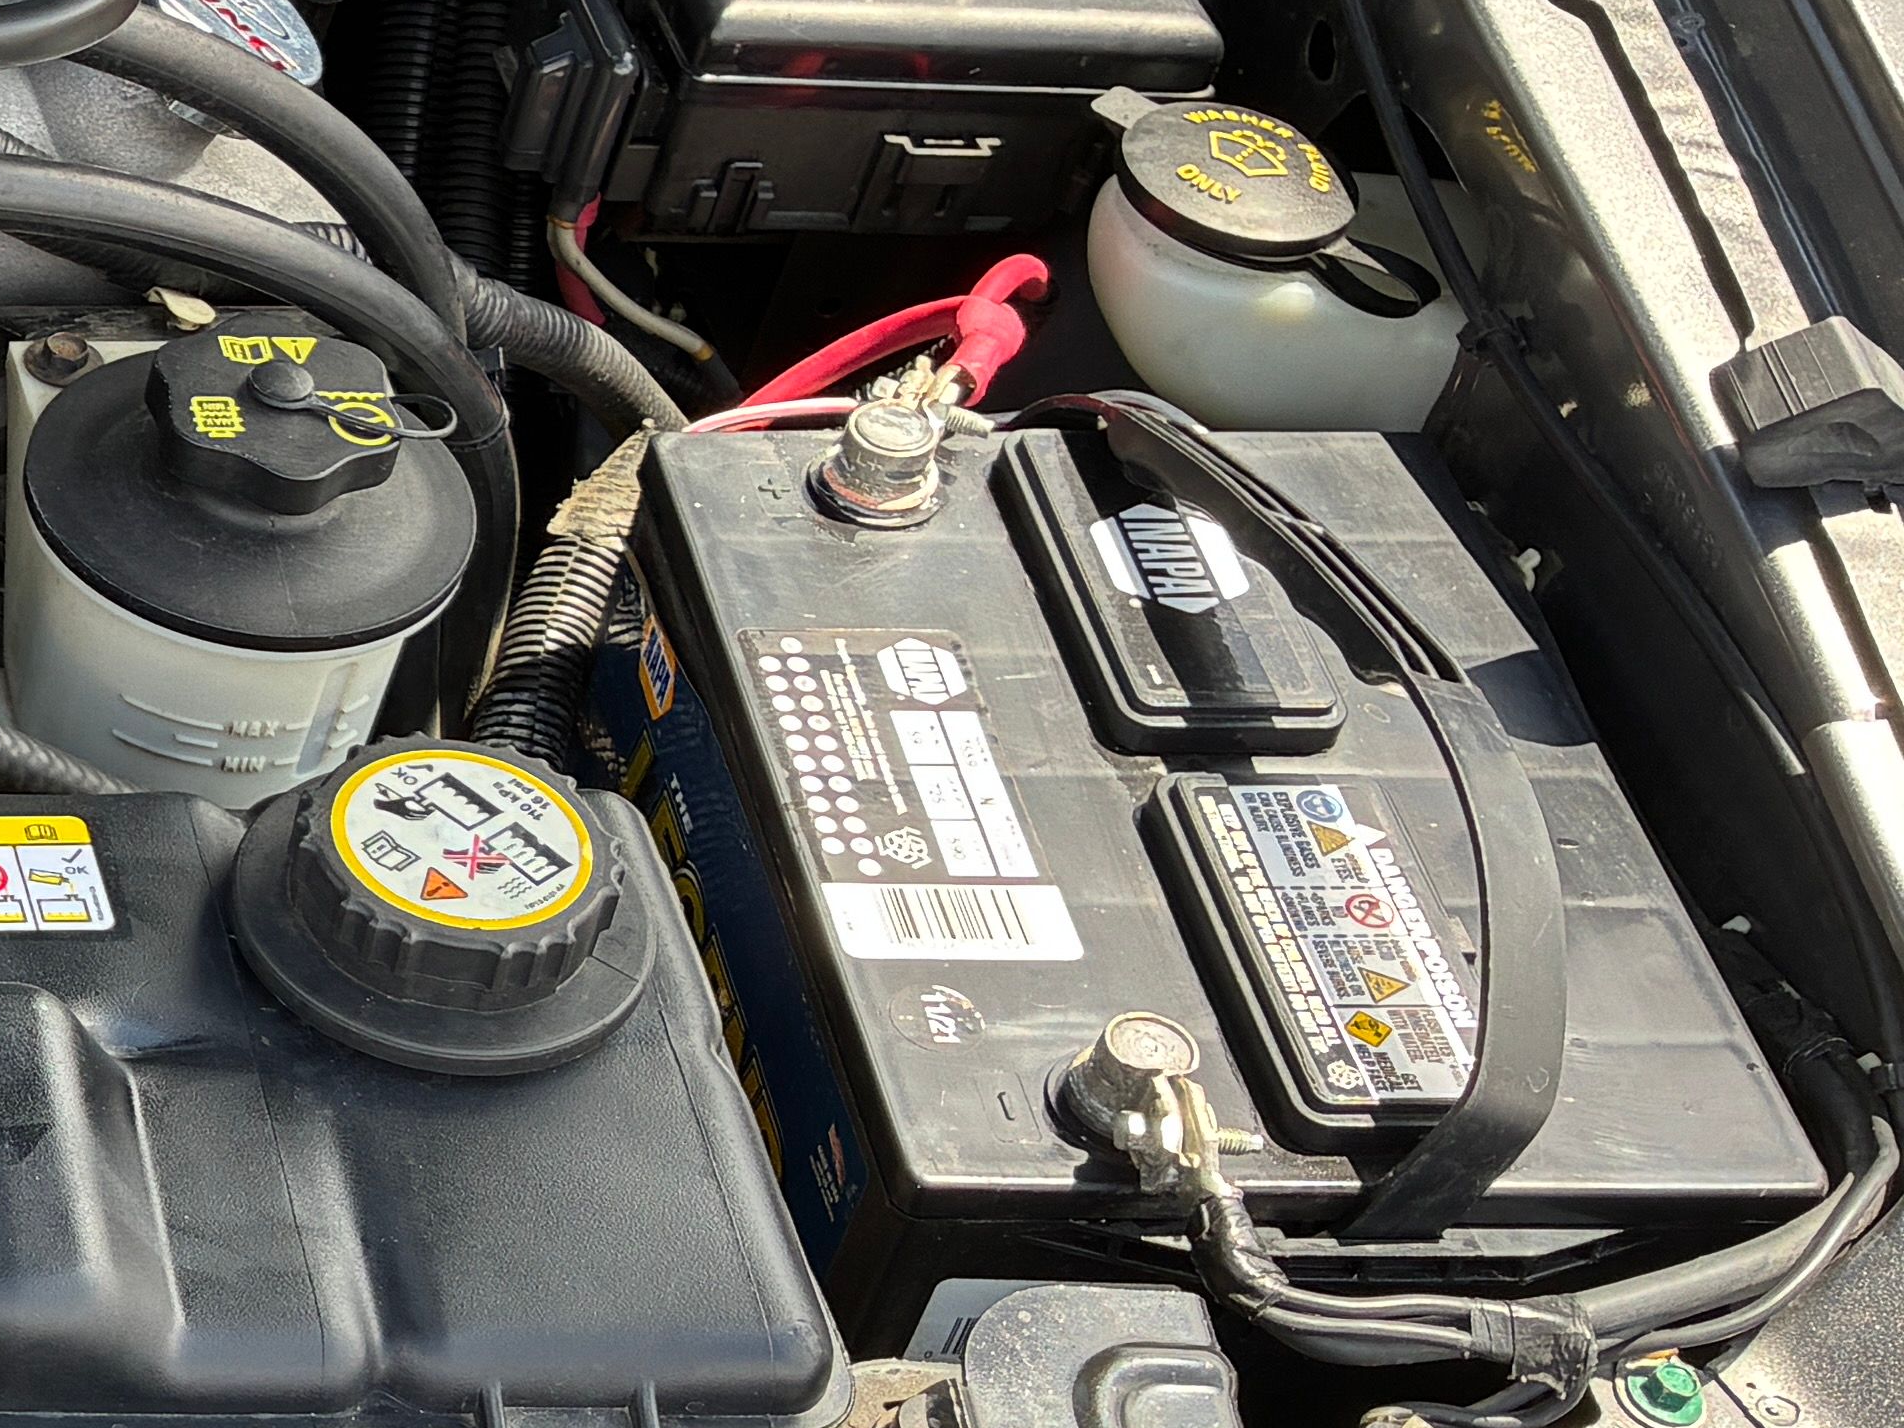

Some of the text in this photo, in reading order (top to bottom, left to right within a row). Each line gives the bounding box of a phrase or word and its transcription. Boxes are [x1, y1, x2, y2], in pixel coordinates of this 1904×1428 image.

[1183, 109, 1332, 193] WASHER FLUID
[1176, 164, 1242, 203] ONLY
[1123, 520, 1214, 596] NAPA
[643, 627, 671, 710] NAPA
[231, 721, 279, 738] MAX
[224, 756, 266, 772] MIN
[391, 767, 418, 785] OK
[492, 782, 544, 821] 110 kPa
[508, 778, 551, 810] 16 psi
[671, 772, 692, 834] THE
[1257, 792, 1272, 807] CAN
[1272, 792, 1320, 869] EXPLOSIVE GASES
[64, 865, 89, 875] OK
[1368, 848, 1477, 1028] DANGER/POISON
[919, 992, 961, 1043] 11/21
[1373, 1052, 1403, 1092] MEDICAL
[1401, 1073, 1423, 1091] GET
